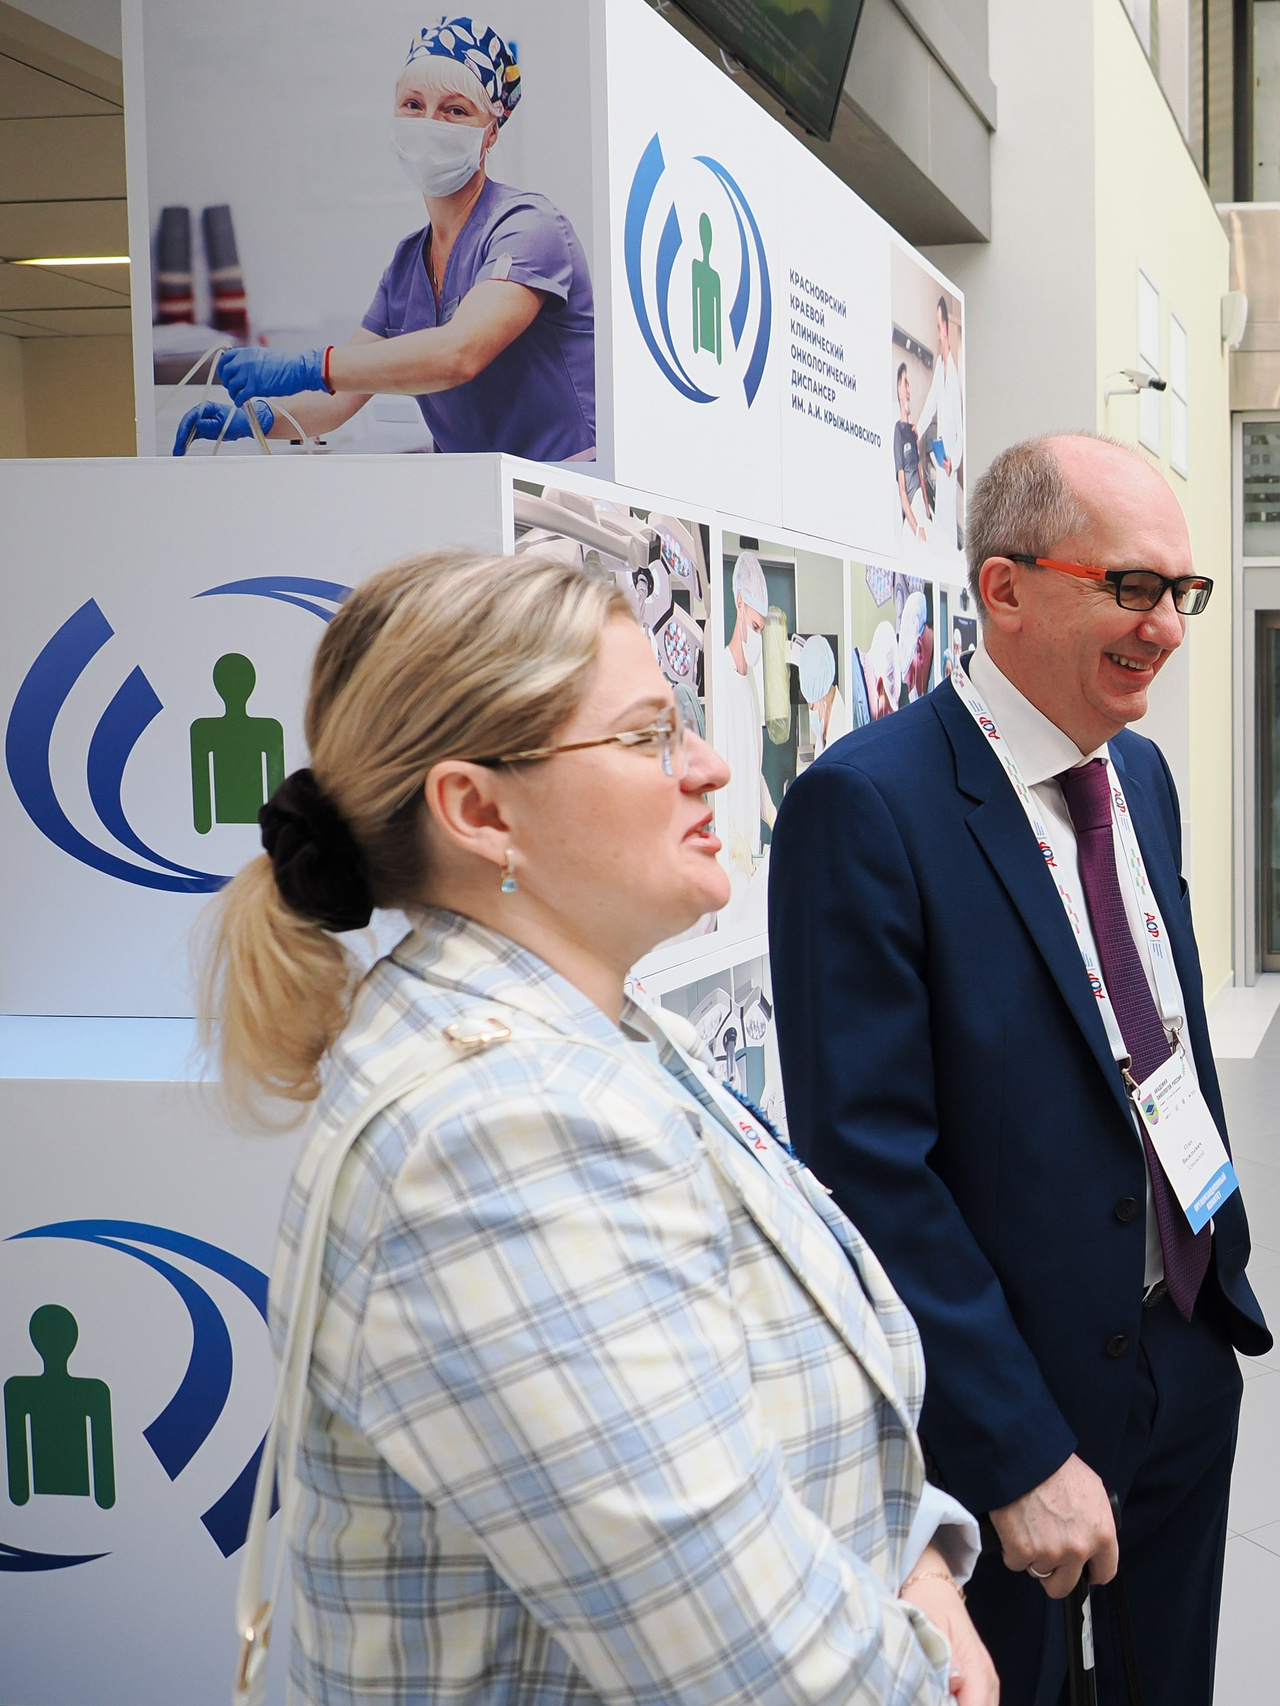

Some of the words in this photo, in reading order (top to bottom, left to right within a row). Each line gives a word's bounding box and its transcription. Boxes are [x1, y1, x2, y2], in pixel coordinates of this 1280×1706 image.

[789, 268, 847, 319] КРАСНОЯРСКИЙ
[789, 293, 825, 328] КРАЕВОЙ
[790, 318, 844, 362] КЛИНИЧЕСКИЙ
[790, 344, 857, 392] ОНКОЛОГИЧЕСКИЙ
[791, 369, 836, 403] ДИСПАНСЕР
[791, 394, 806, 413] ИМ.
[823, 410, 882, 448] КРЫЖАНОВСКОГО
